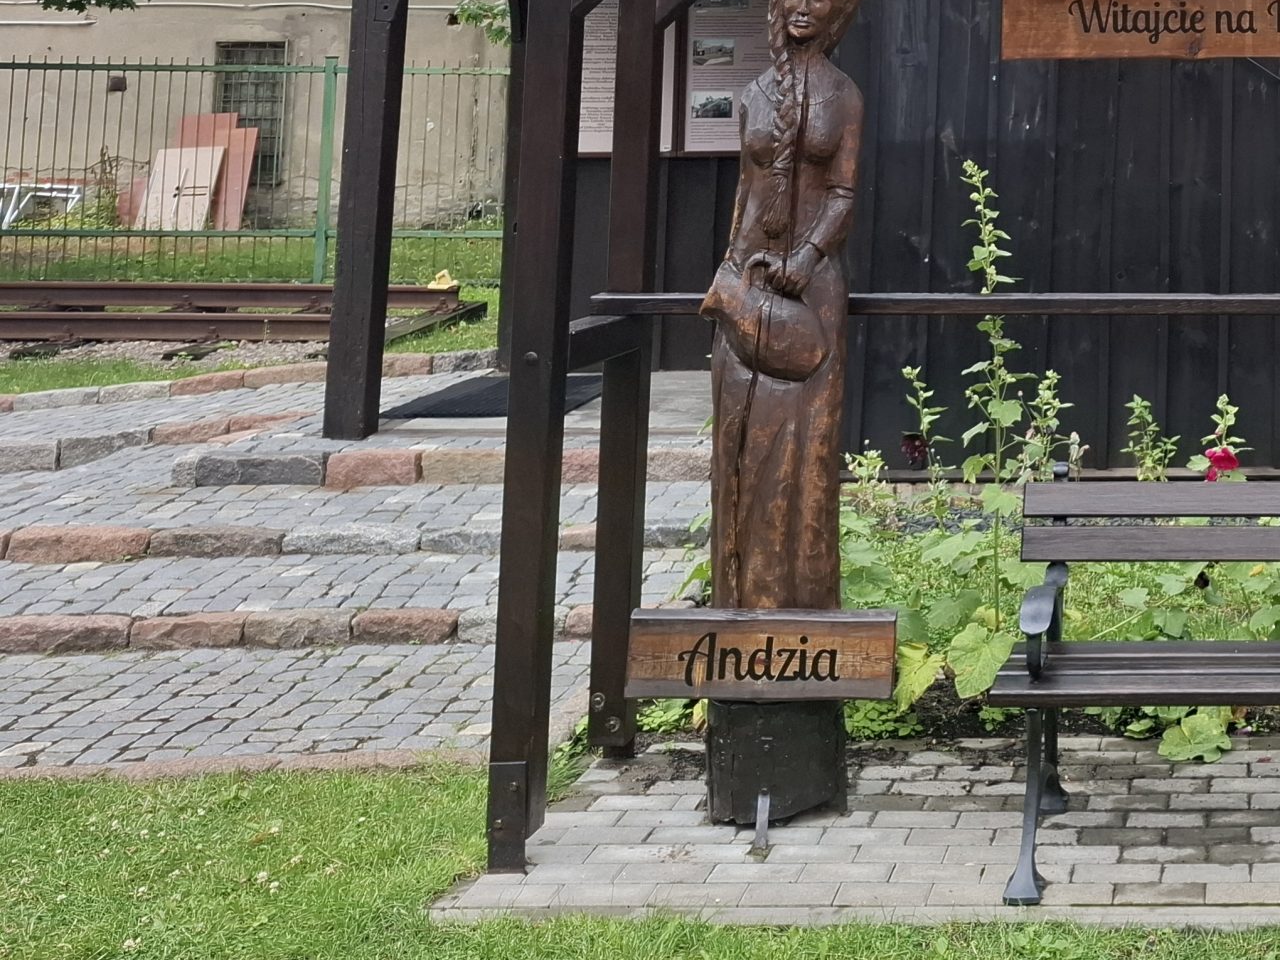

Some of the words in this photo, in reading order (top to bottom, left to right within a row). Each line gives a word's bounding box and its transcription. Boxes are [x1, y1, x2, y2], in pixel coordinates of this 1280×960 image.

[1068, 0, 1206, 44] Witajcie
[1215, 9, 1257, 34] na
[678, 632, 840, 687] Andzia
